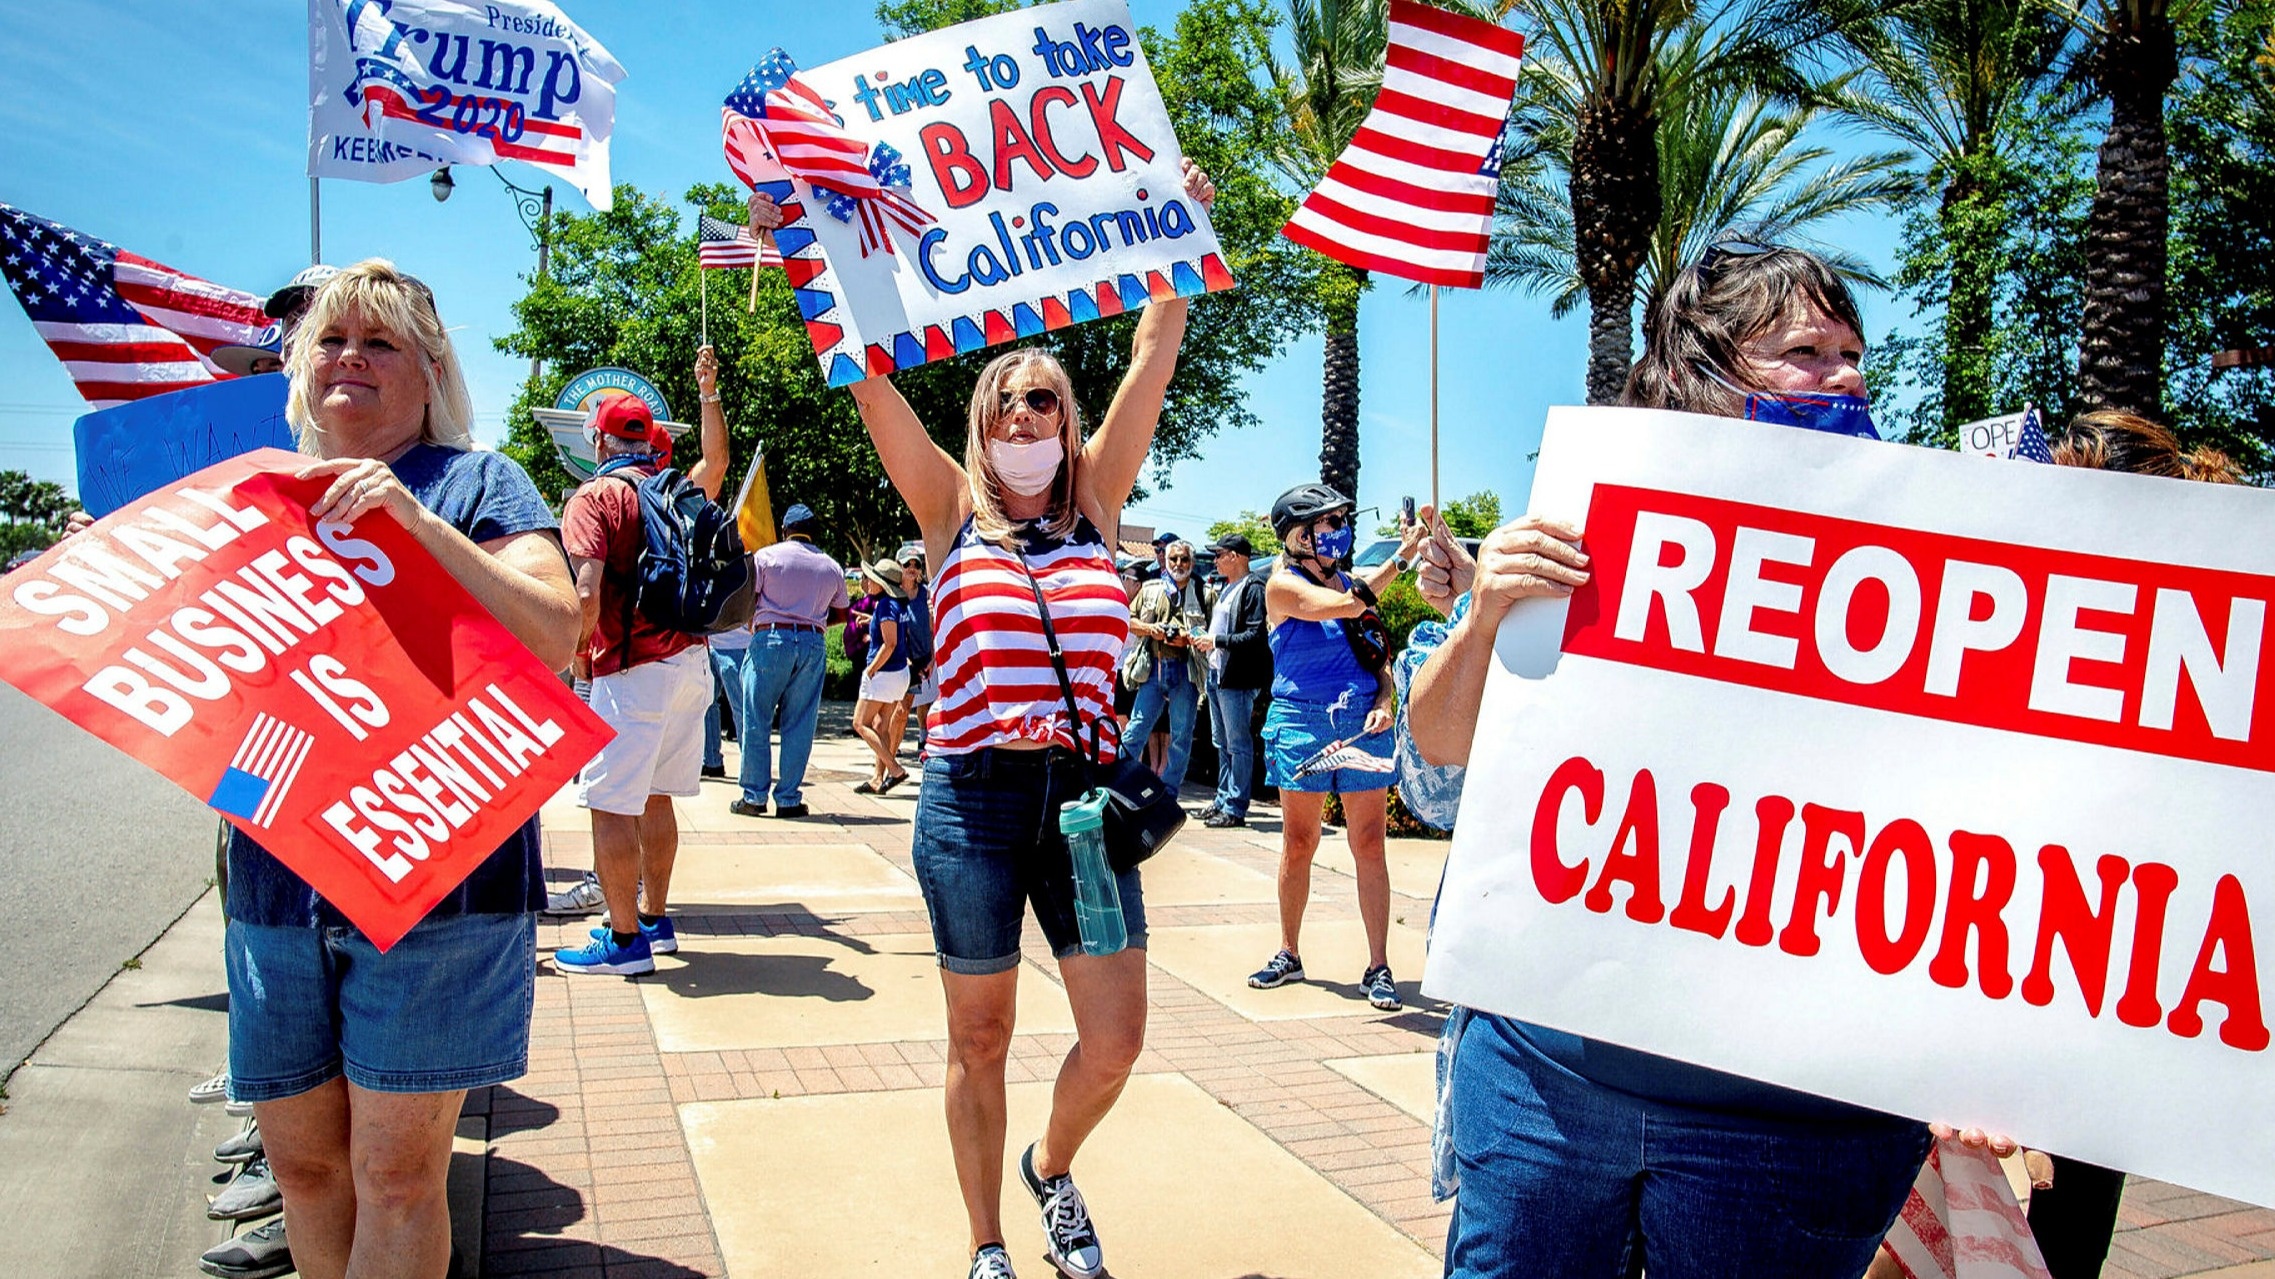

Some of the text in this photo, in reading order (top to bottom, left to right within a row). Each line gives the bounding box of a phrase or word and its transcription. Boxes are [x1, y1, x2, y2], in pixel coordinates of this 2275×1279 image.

[416, 84, 525, 143] 2020
[964, 45, 1020, 93] to
[1033, 22, 1134, 79] take
[919, 75, 1155, 209] BACK
[918, 188, 1195, 295] California
[564, 373, 663, 416] THE MOTHER ROAD
[1971, 418, 2022, 450] OPE
[13, 487, 270, 636] SMALL
[81, 519, 396, 738] BUSINESS
[1614, 510, 2267, 742] REOPEN
[289, 653, 391, 742] IS
[320, 683, 565, 884] ESSENTIAL
[1529, 755, 2270, 1052] CALIFORNIA
